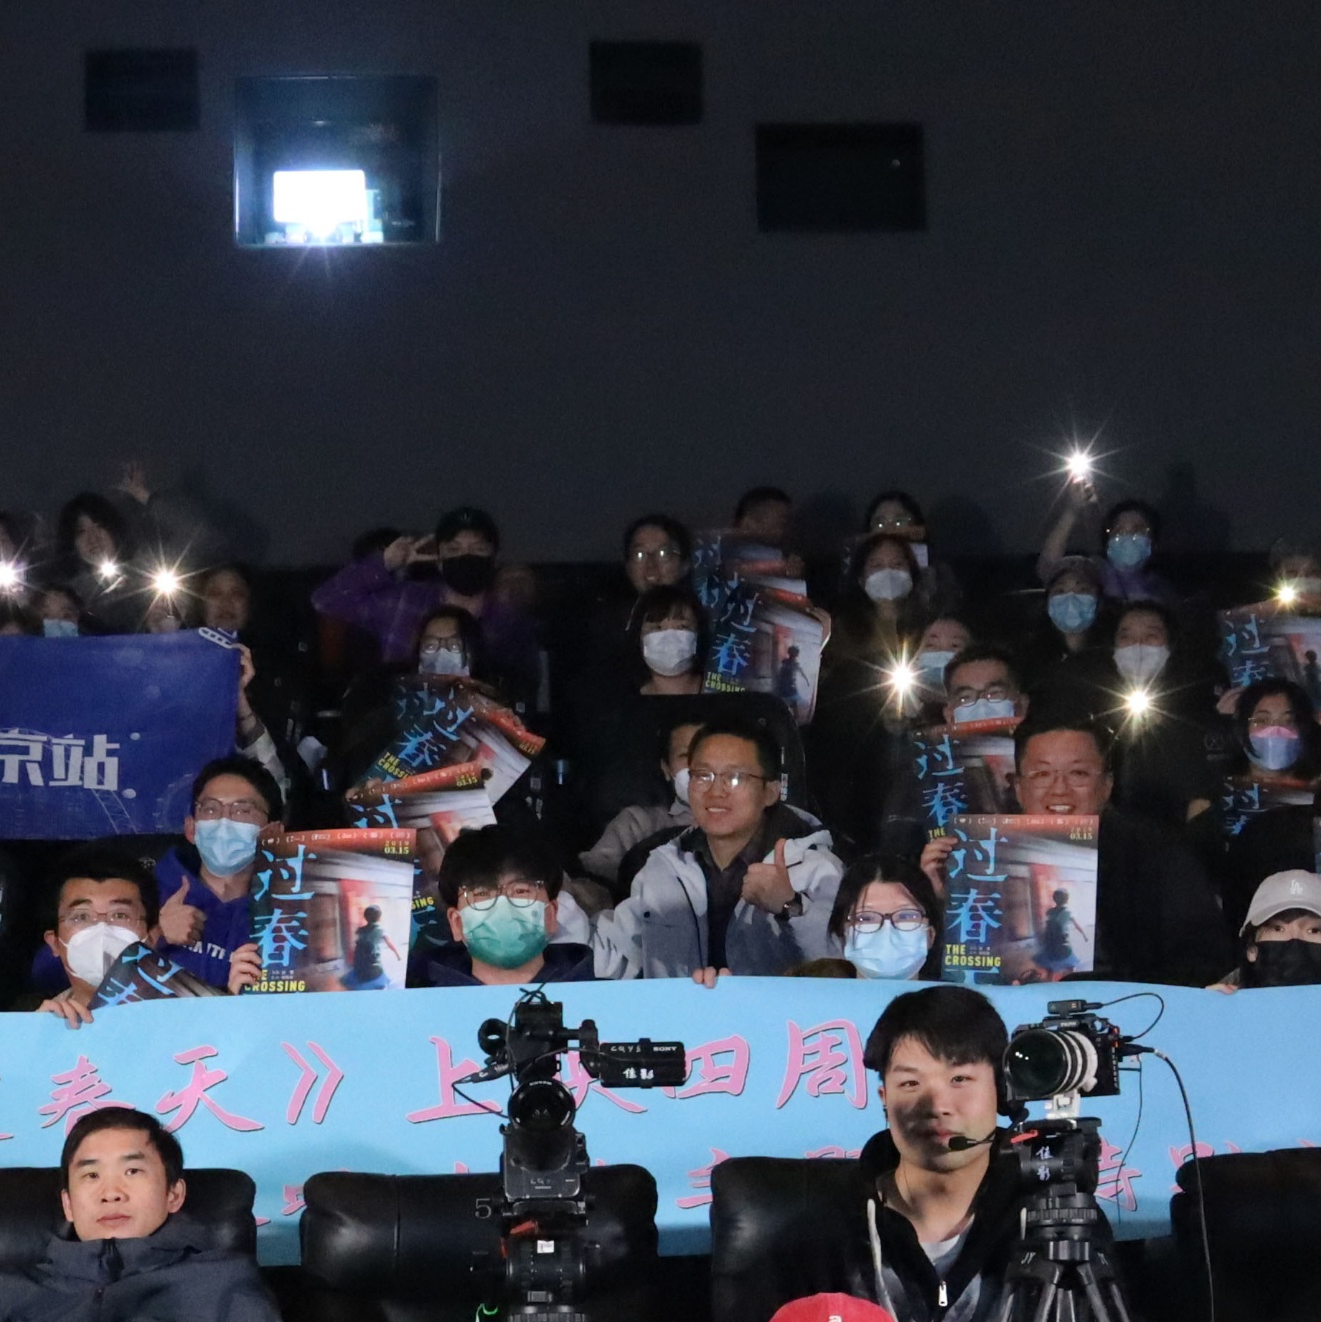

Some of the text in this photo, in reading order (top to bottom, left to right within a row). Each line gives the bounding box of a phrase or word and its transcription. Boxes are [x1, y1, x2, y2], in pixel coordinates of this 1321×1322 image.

[383, 846, 410, 855] 03.15
[249, 843, 318, 969] 过春
[945, 943, 967, 956] THE
[944, 954, 1002, 968] CROSSING
[474, 1198, 493, 1219] 5
